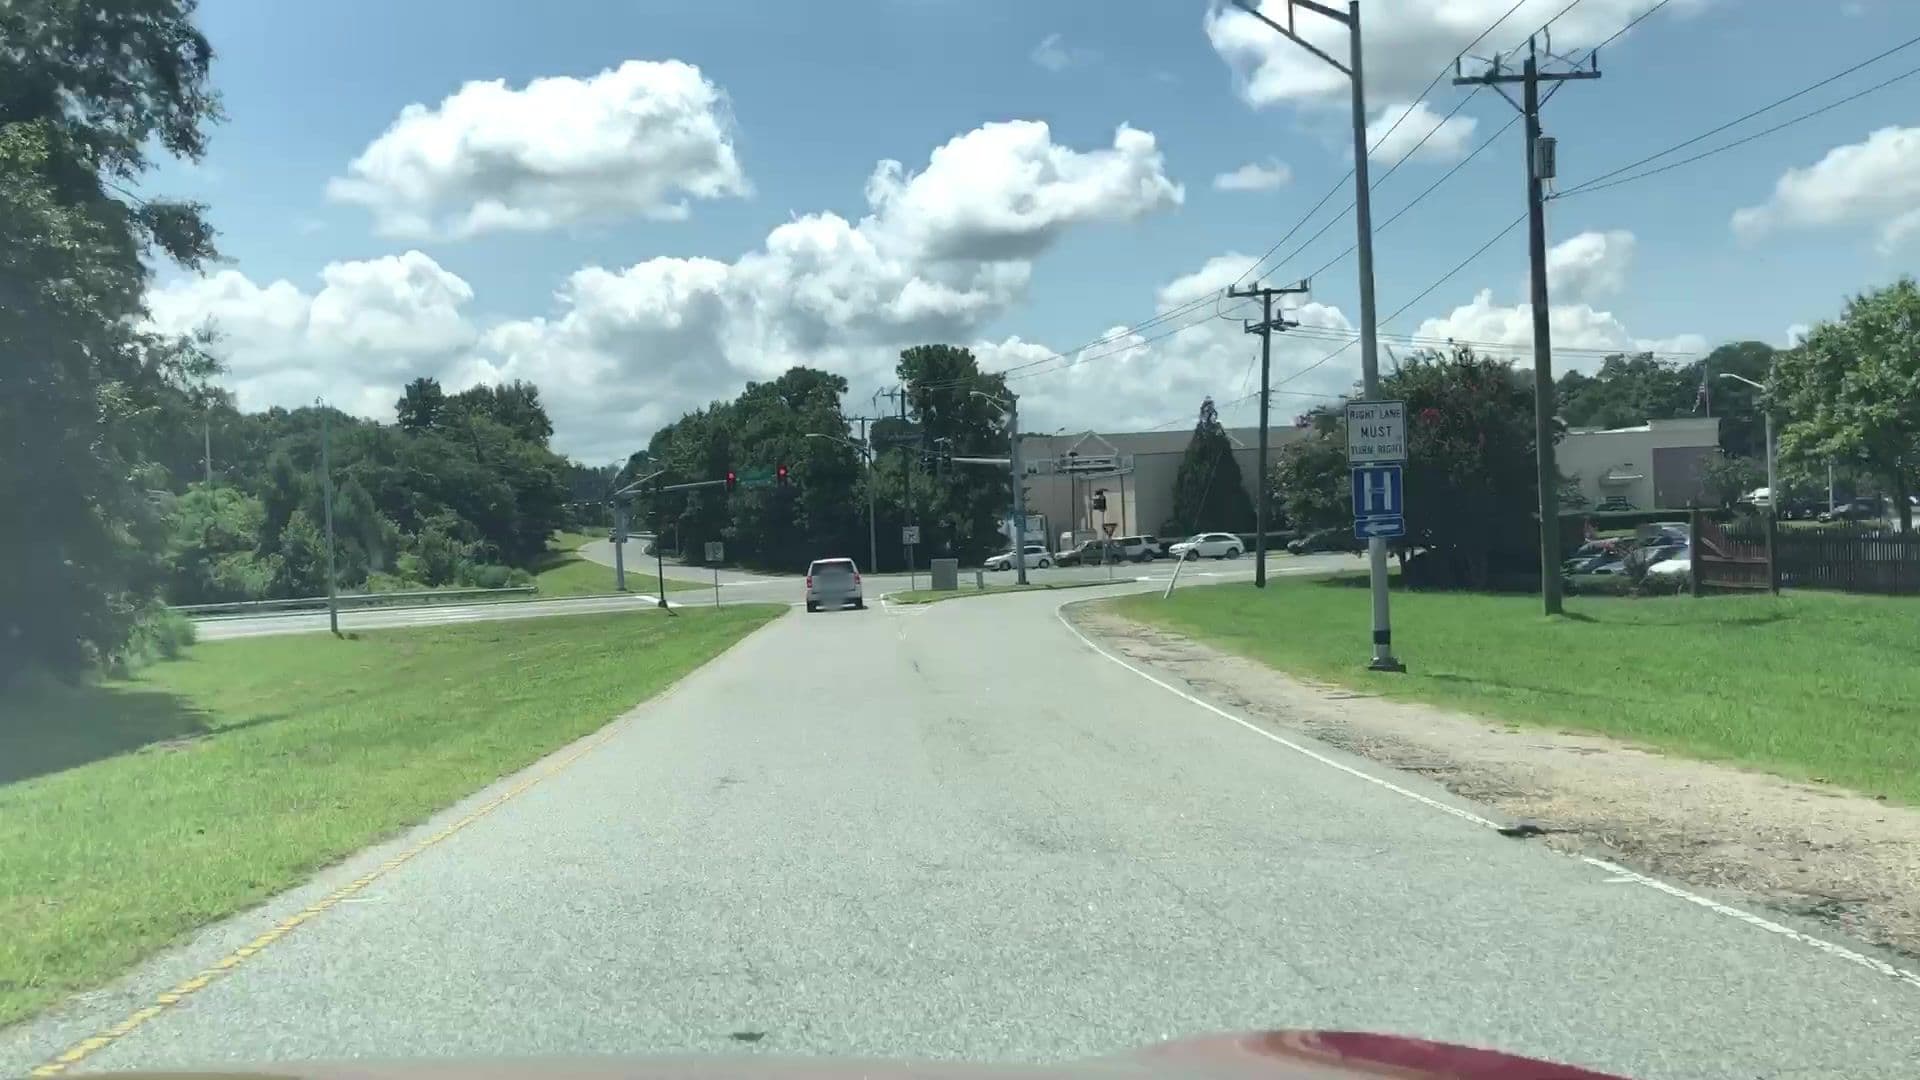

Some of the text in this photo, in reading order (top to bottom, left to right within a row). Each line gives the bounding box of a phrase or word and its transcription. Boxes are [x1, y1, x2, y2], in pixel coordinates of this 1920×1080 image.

[1350, 408, 1401, 420] RIGHT LANE
[1361, 425, 1392, 438] MUST
[1351, 444, 1402, 455] TURN RIGHT
[1363, 471, 1391, 511] H
